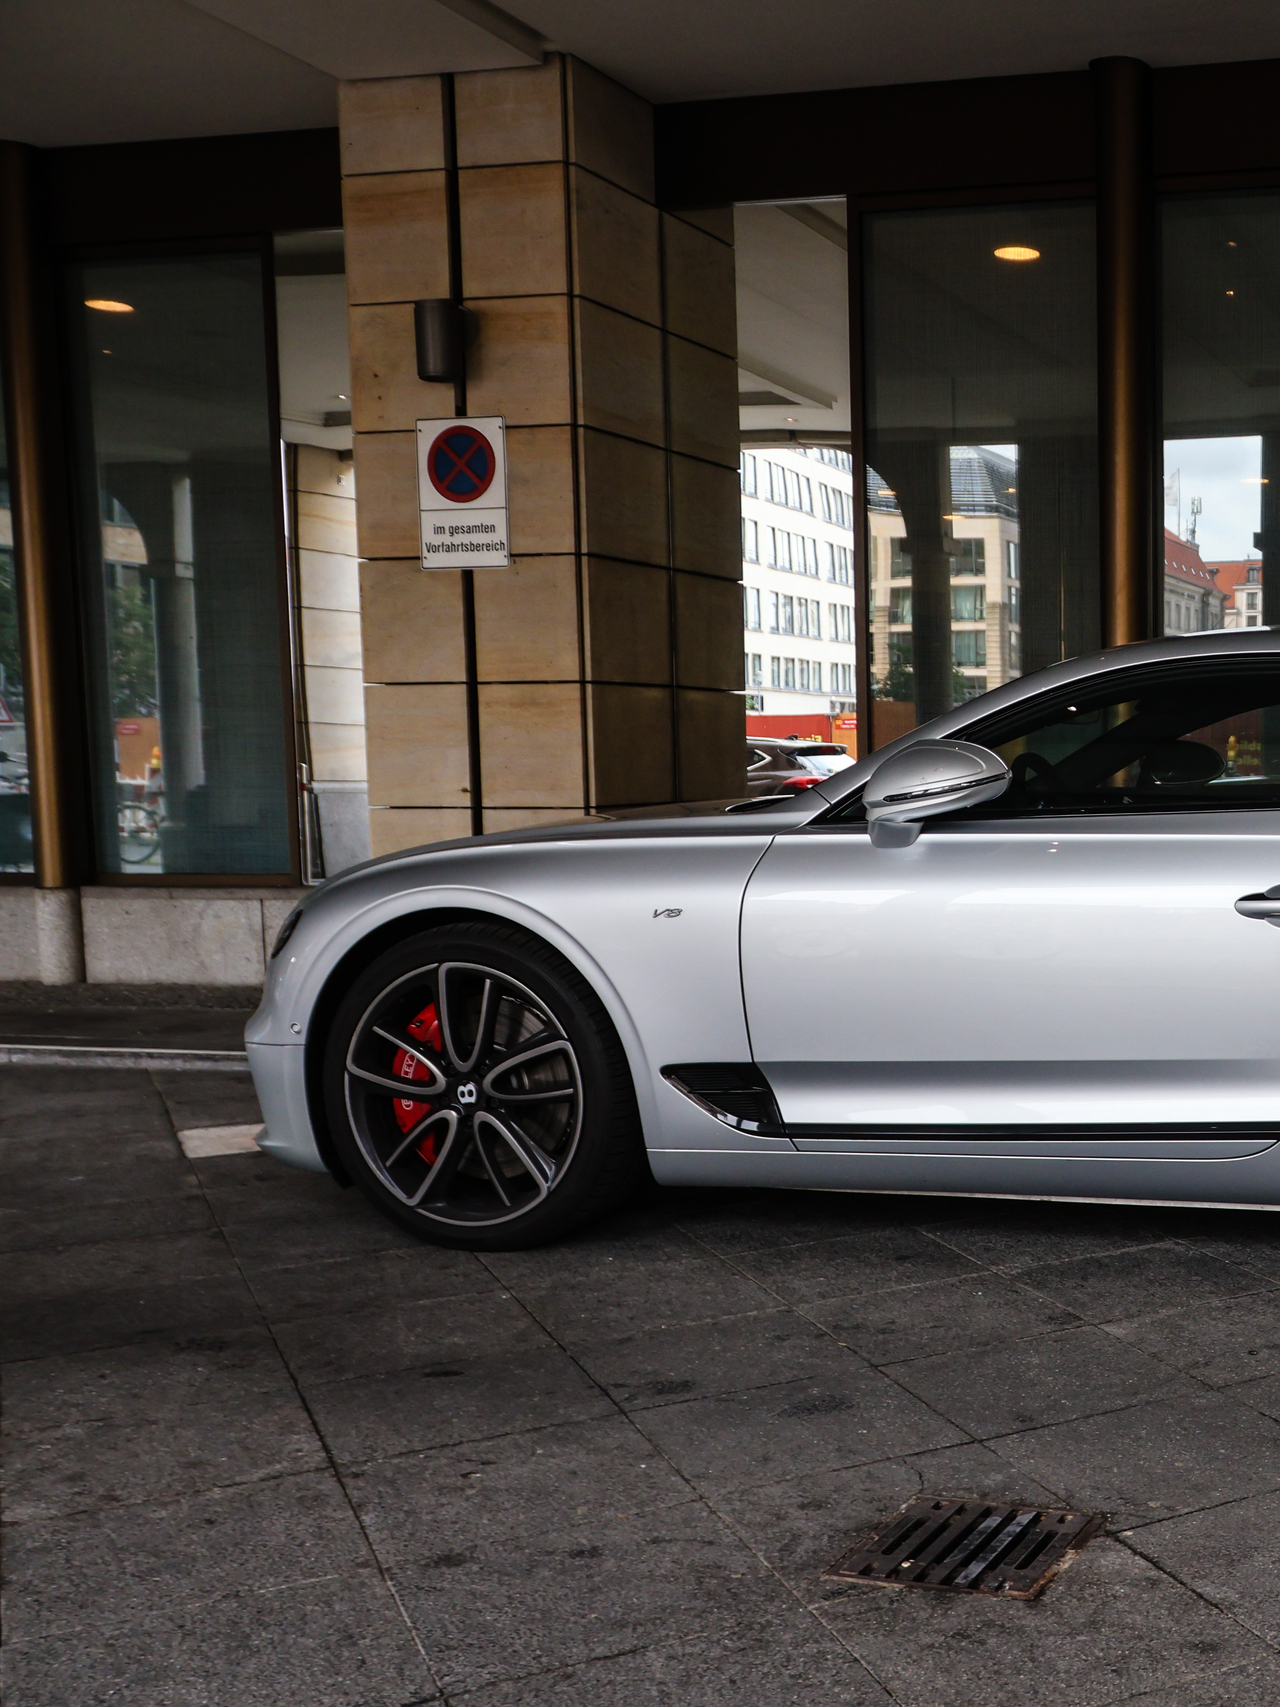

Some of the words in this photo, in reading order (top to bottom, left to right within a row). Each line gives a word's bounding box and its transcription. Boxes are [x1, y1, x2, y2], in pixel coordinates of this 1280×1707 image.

[433, 523, 446, 535] im
[448, 522, 496, 537] gesamten
[425, 540, 506, 553] Vorfahrtsbereich
[652, 908, 683, 919] V8
